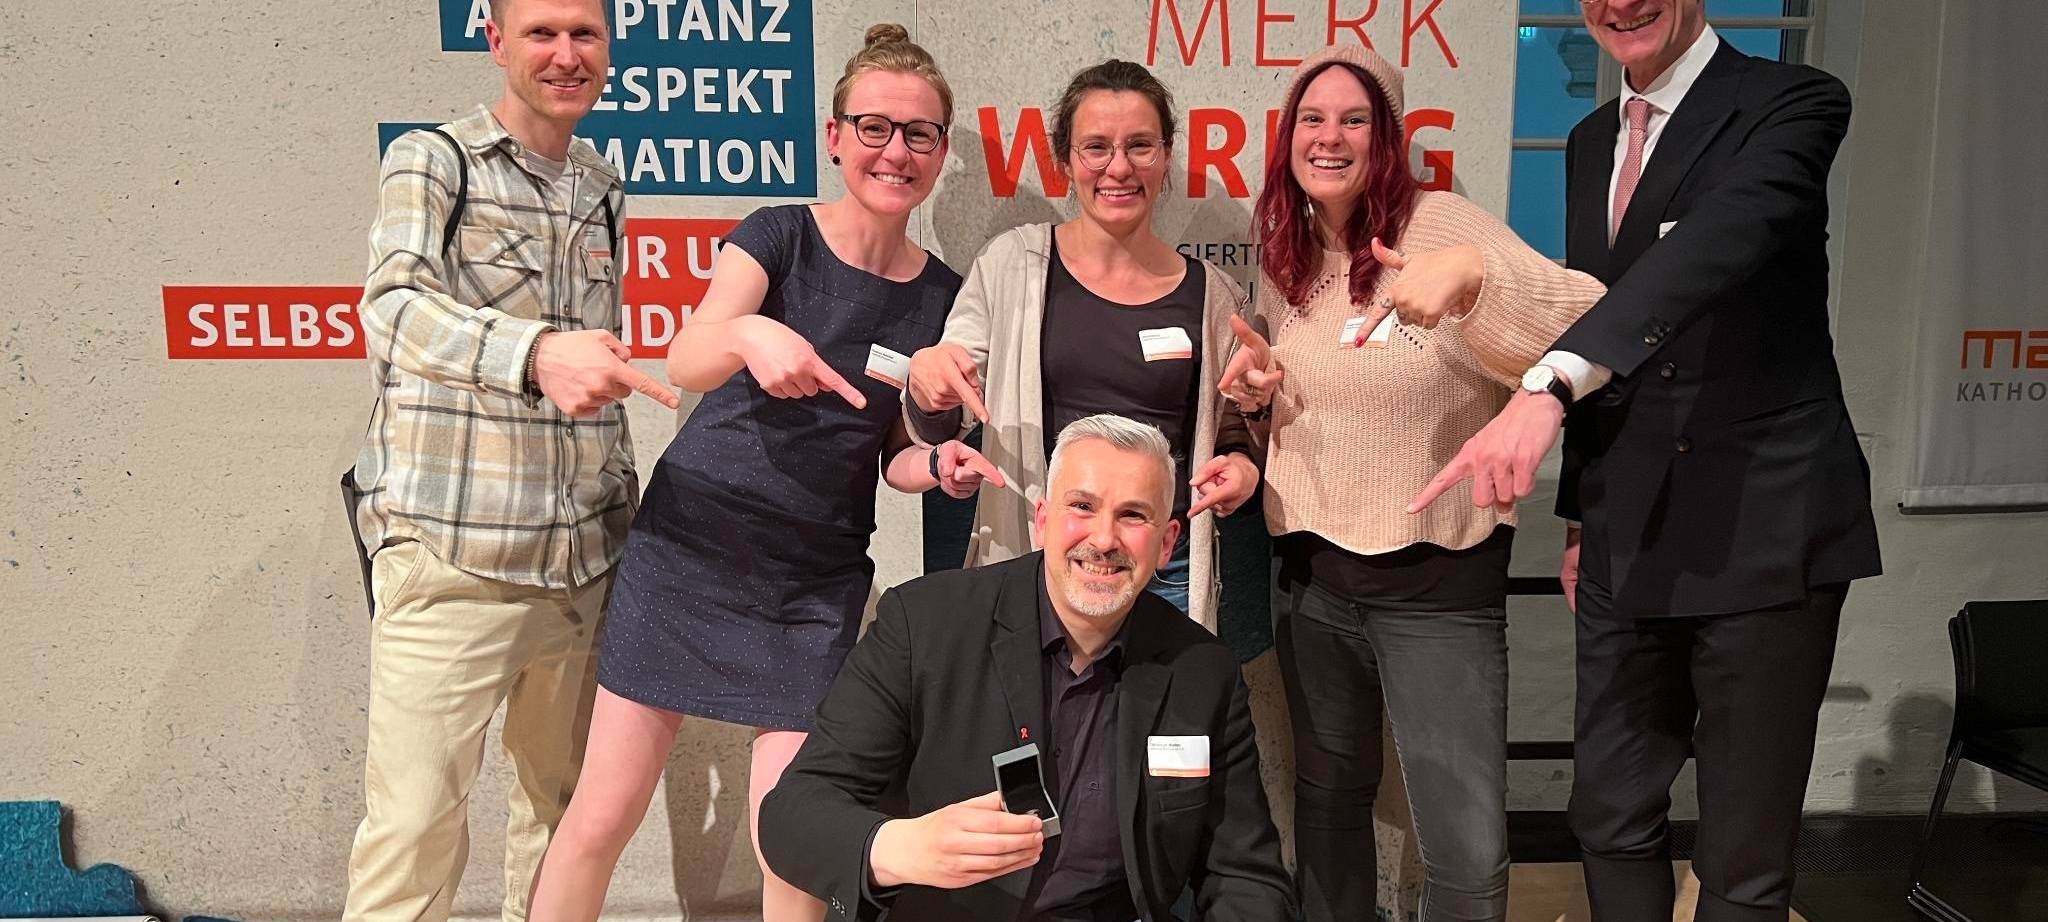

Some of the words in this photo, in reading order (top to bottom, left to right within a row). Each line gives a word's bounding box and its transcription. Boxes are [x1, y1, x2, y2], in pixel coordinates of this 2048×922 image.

[464, 0, 791, 42] APTANZ
[1146, 0, 1458, 68] MERK
[592, 66, 792, 113] ESPEKT
[1956, 382, 2048, 402] KATHO
